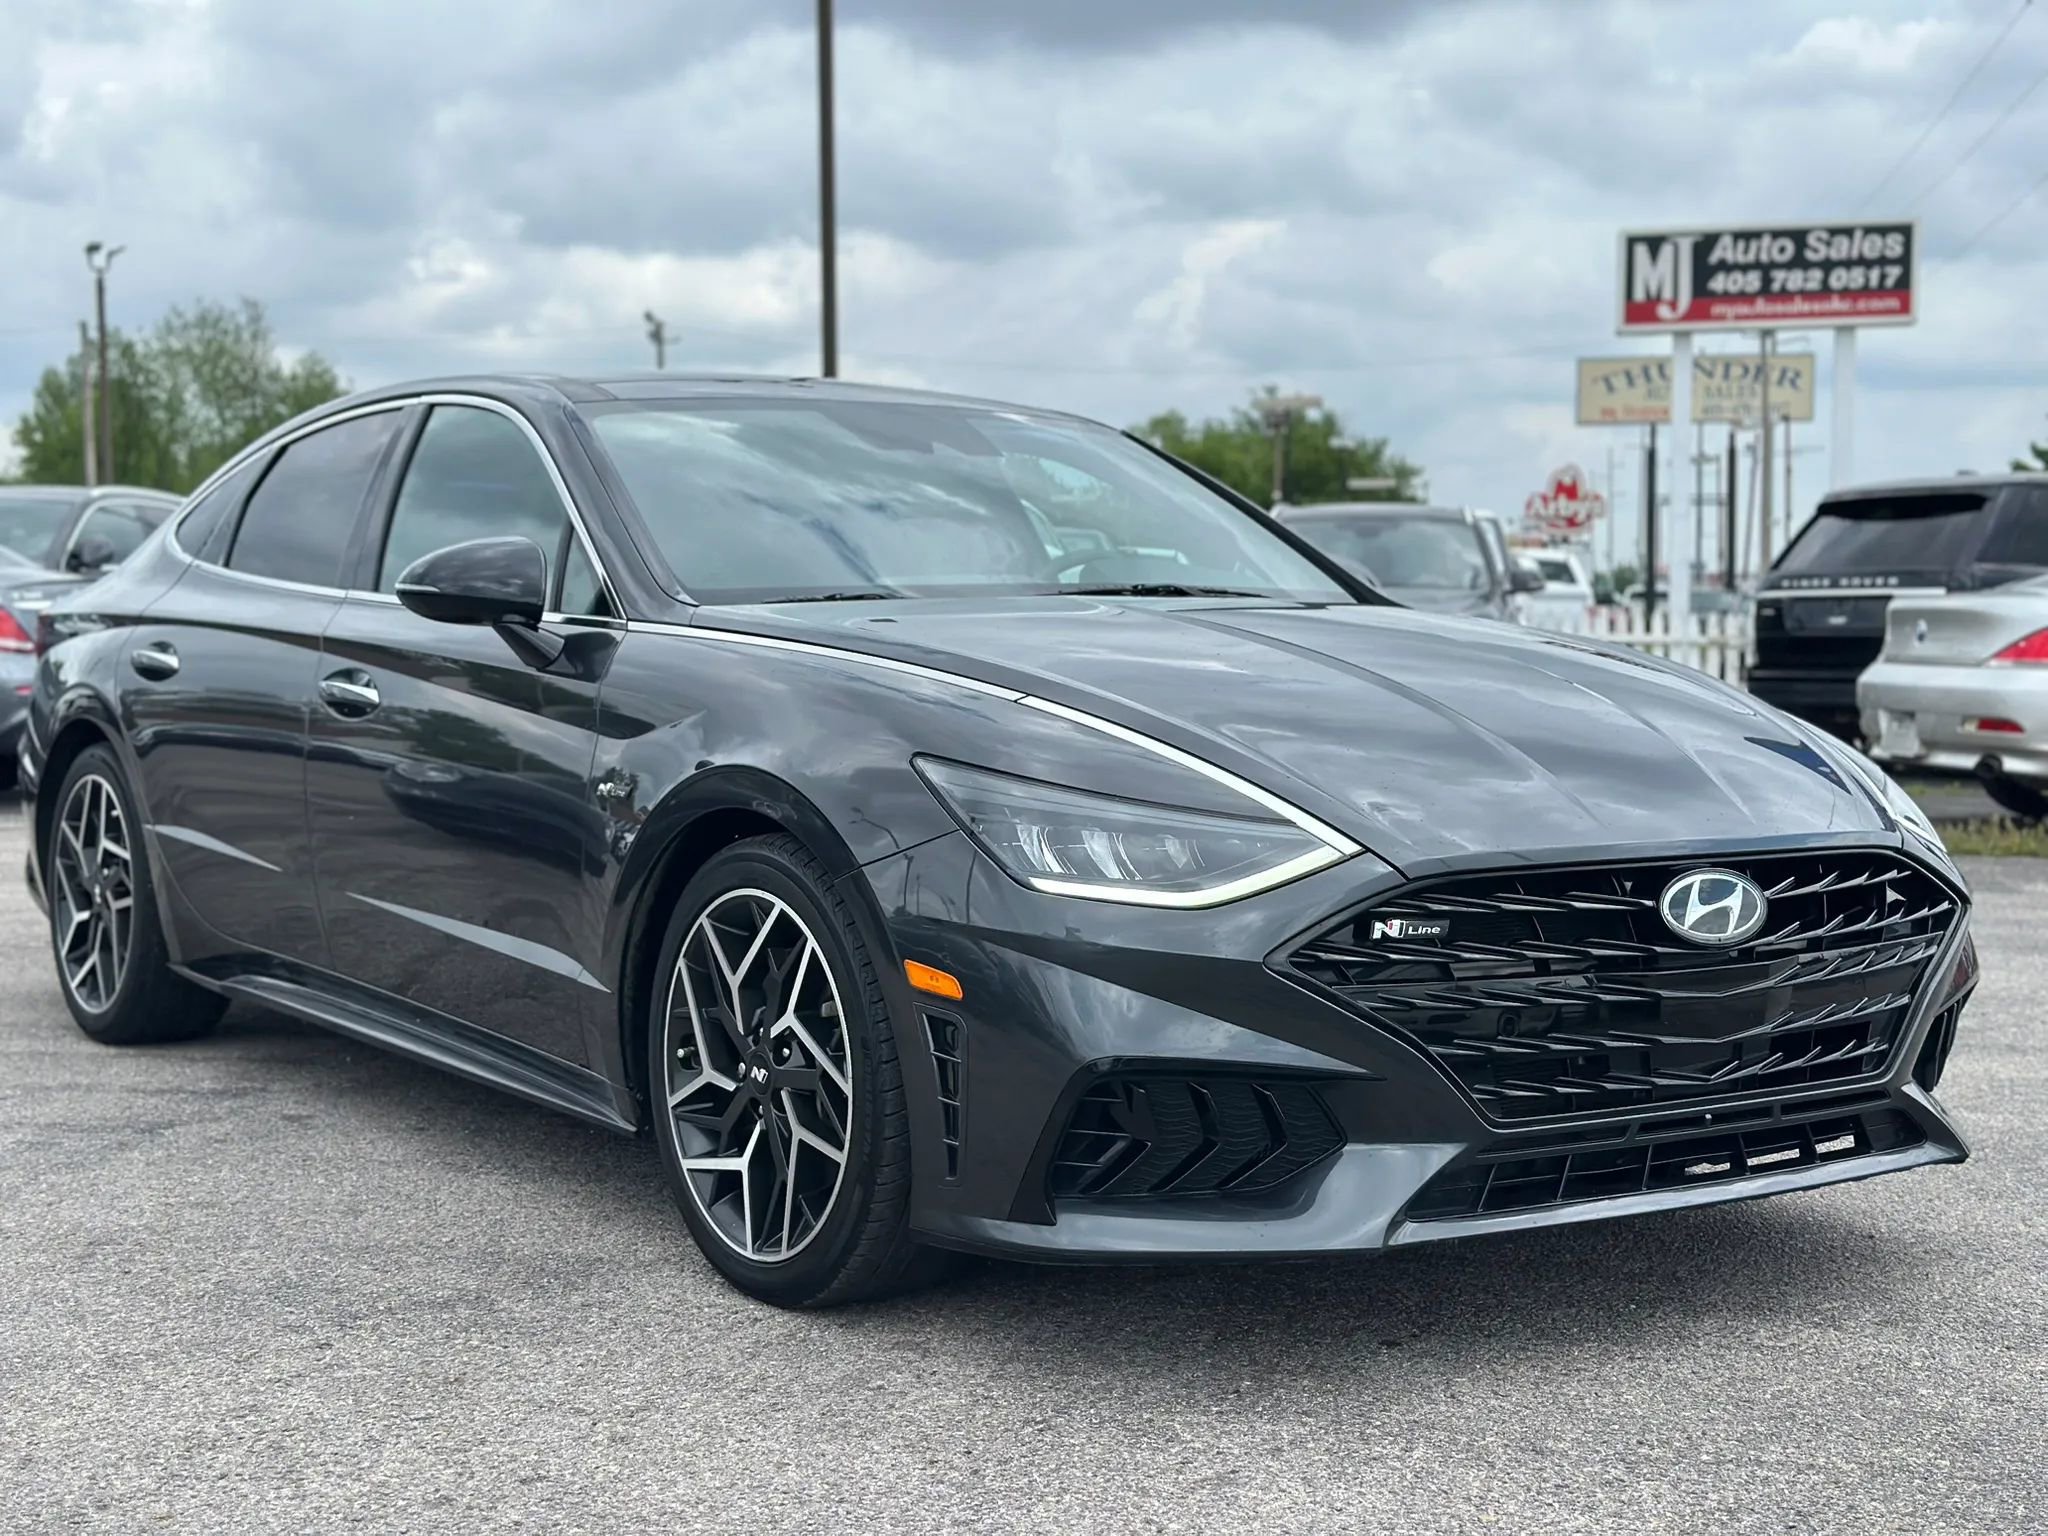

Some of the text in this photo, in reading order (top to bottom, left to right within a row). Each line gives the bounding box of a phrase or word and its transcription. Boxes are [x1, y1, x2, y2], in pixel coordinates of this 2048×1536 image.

[1707, 228, 1905, 265] Auto Sales
[1632, 236, 1703, 321] MJ
[1706, 269, 1763, 294] 405
[1828, 265, 1904, 290] 0517
[1407, 925, 1441, 935] Line
